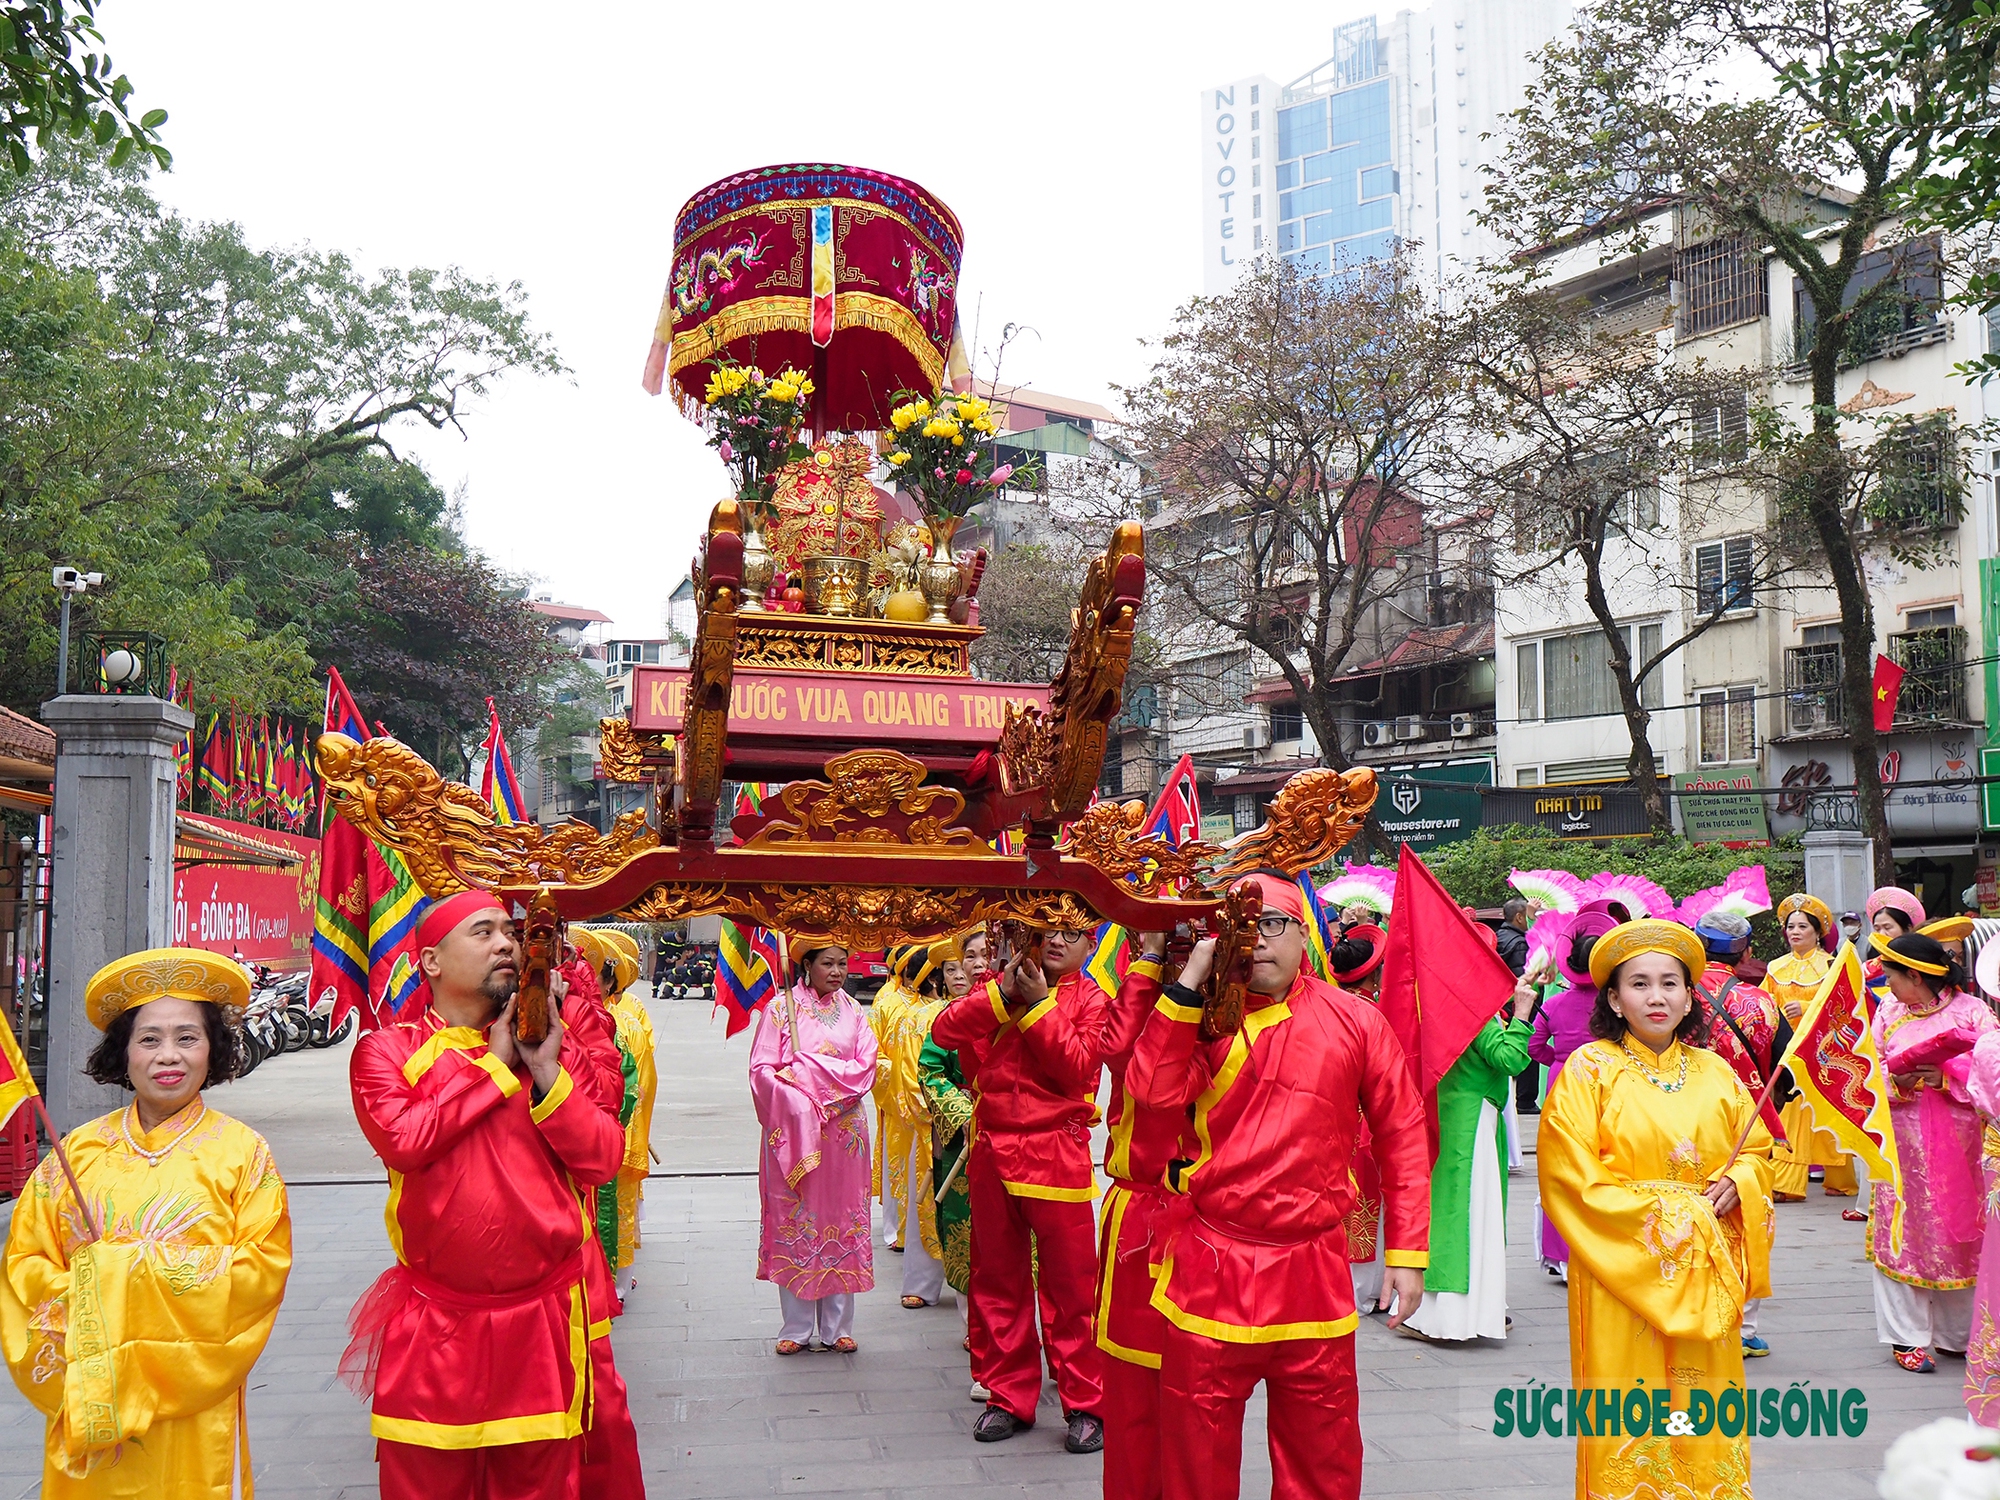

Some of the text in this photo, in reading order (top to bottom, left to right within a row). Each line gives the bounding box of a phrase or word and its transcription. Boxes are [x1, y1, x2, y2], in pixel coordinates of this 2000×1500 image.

[1215, 85, 1236, 266] NOVOTEL
[650, 675, 688, 724] KIỆ
[796, 686, 853, 723] VUA
[863, 689, 950, 727] QUANG
[172, 878, 188, 943] ỒI
[200, 881, 234, 942] ĐỐNG
[235, 902, 251, 940] ĐA
